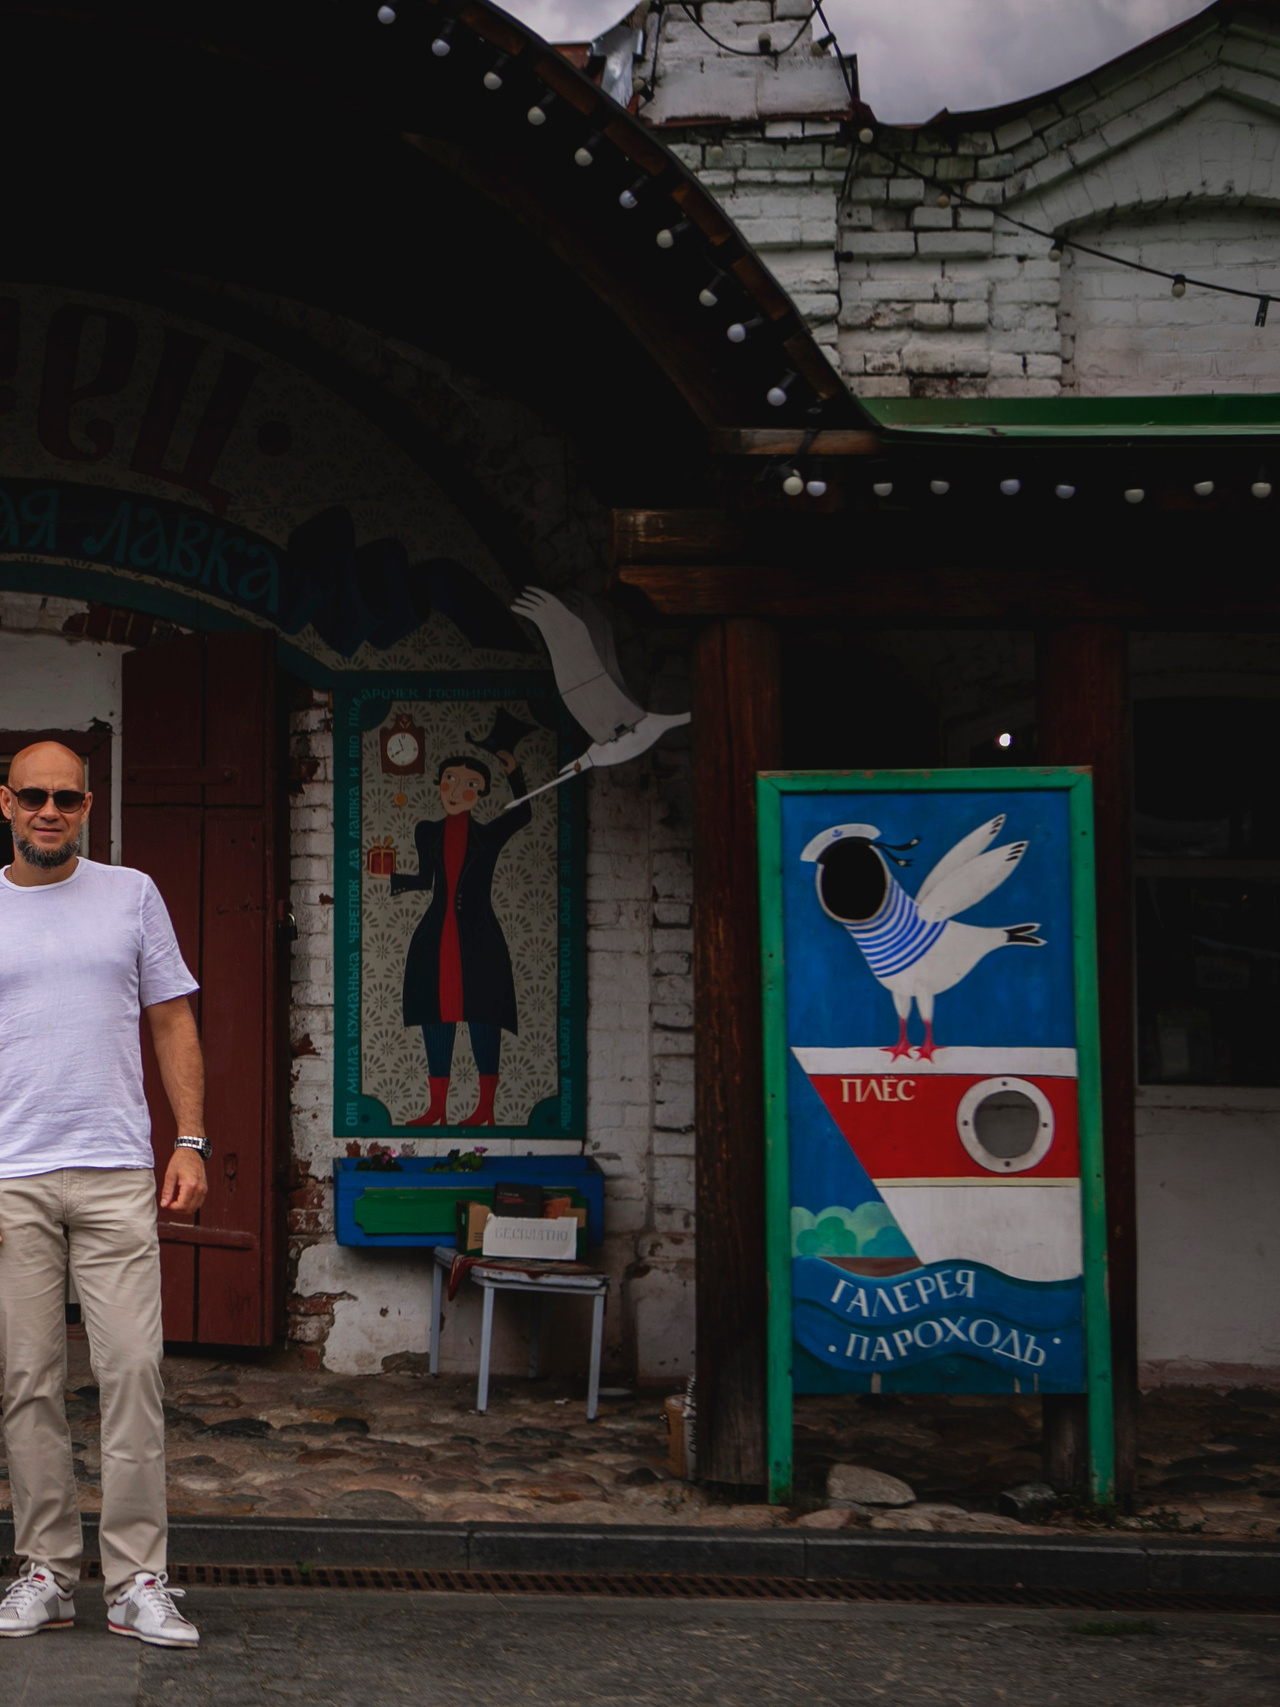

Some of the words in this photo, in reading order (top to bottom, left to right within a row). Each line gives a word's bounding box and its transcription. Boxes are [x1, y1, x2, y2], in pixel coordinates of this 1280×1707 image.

[840, 1075, 916, 1103] ПЛЁС
[495, 1227, 568, 1241] БЕСПЛАТНО
[830, 1270, 976, 1318] ГАЛЕРЕЯ
